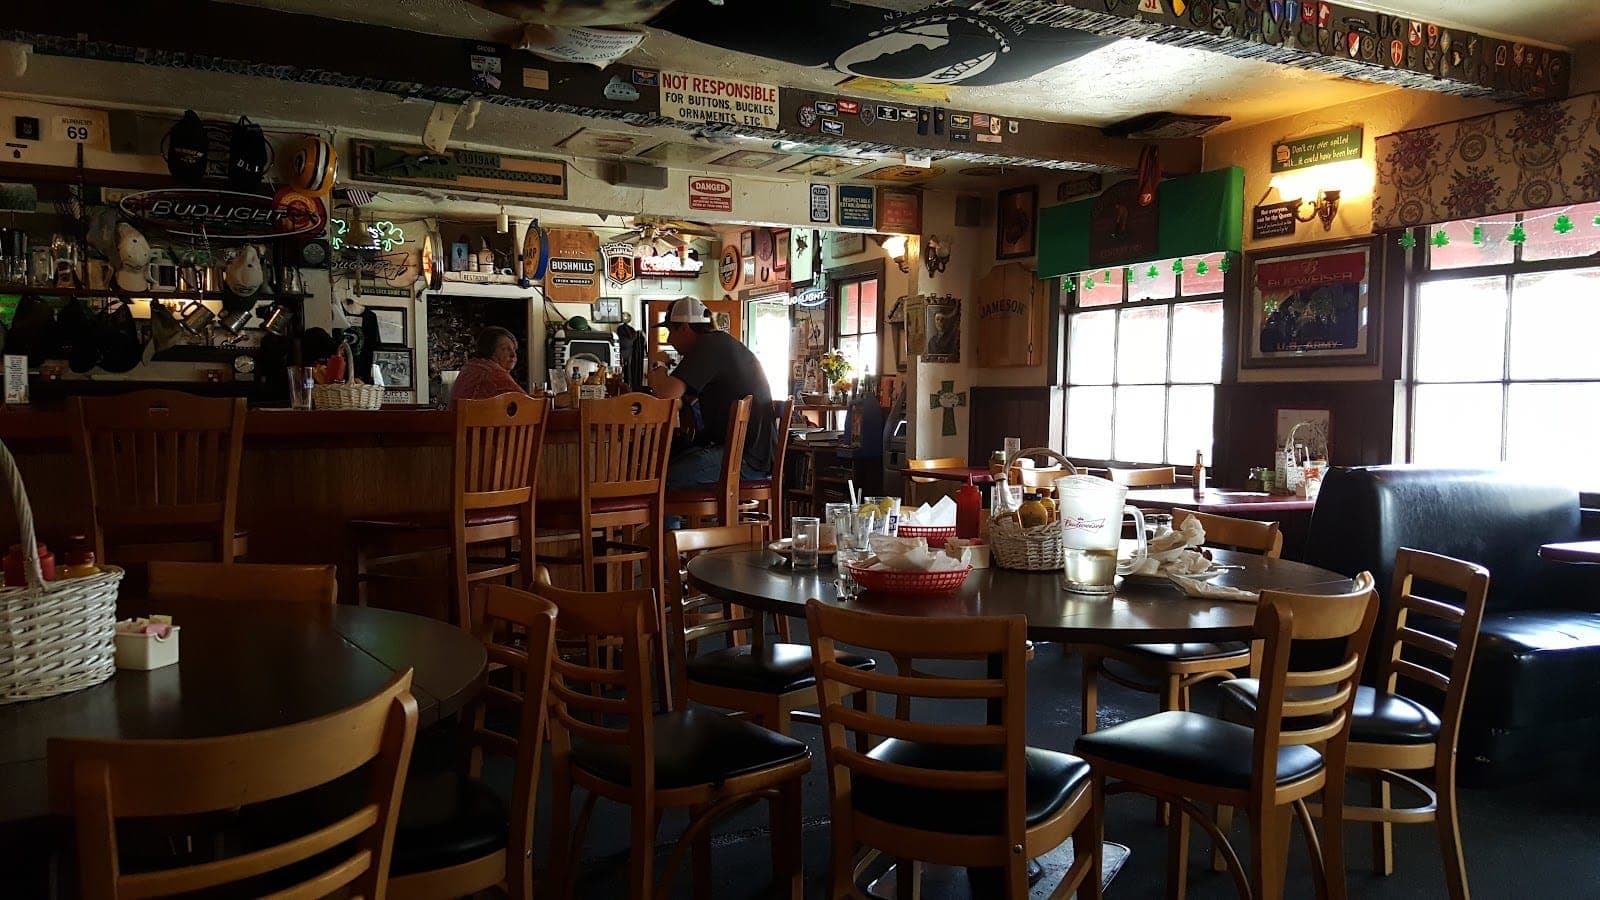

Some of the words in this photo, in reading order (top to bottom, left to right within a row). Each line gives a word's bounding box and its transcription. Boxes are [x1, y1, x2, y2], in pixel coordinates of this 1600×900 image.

[662, 73, 688, 91] NOT
[693, 78, 776, 103] RESPONSIBLE
[665, 92, 684, 104] FOR
[688, 95, 732, 111] BUTTONS,
[736, 101, 776, 117] BUCKLES,
[67, 126, 88, 140] 69
[1291, 143, 1307, 154] Don't
[1306, 144, 1316, 152] cry
[1316, 140, 1329, 150] over
[1330, 134, 1349, 147] spilled
[1304, 153, 1319, 164] could
[1320, 151, 1332, 161] have
[1332, 149, 1346, 159] been
[695, 181, 727, 192] DANGER
[151, 200, 209, 216] BUD
[213, 204, 288, 221] LIGHT
[552, 261, 594, 272] BUSHMILLS
[1267, 271, 1353, 287] BUDWEISER
[801, 290, 826, 303] LIGHT
[979, 299, 1026, 319] JAMESON
